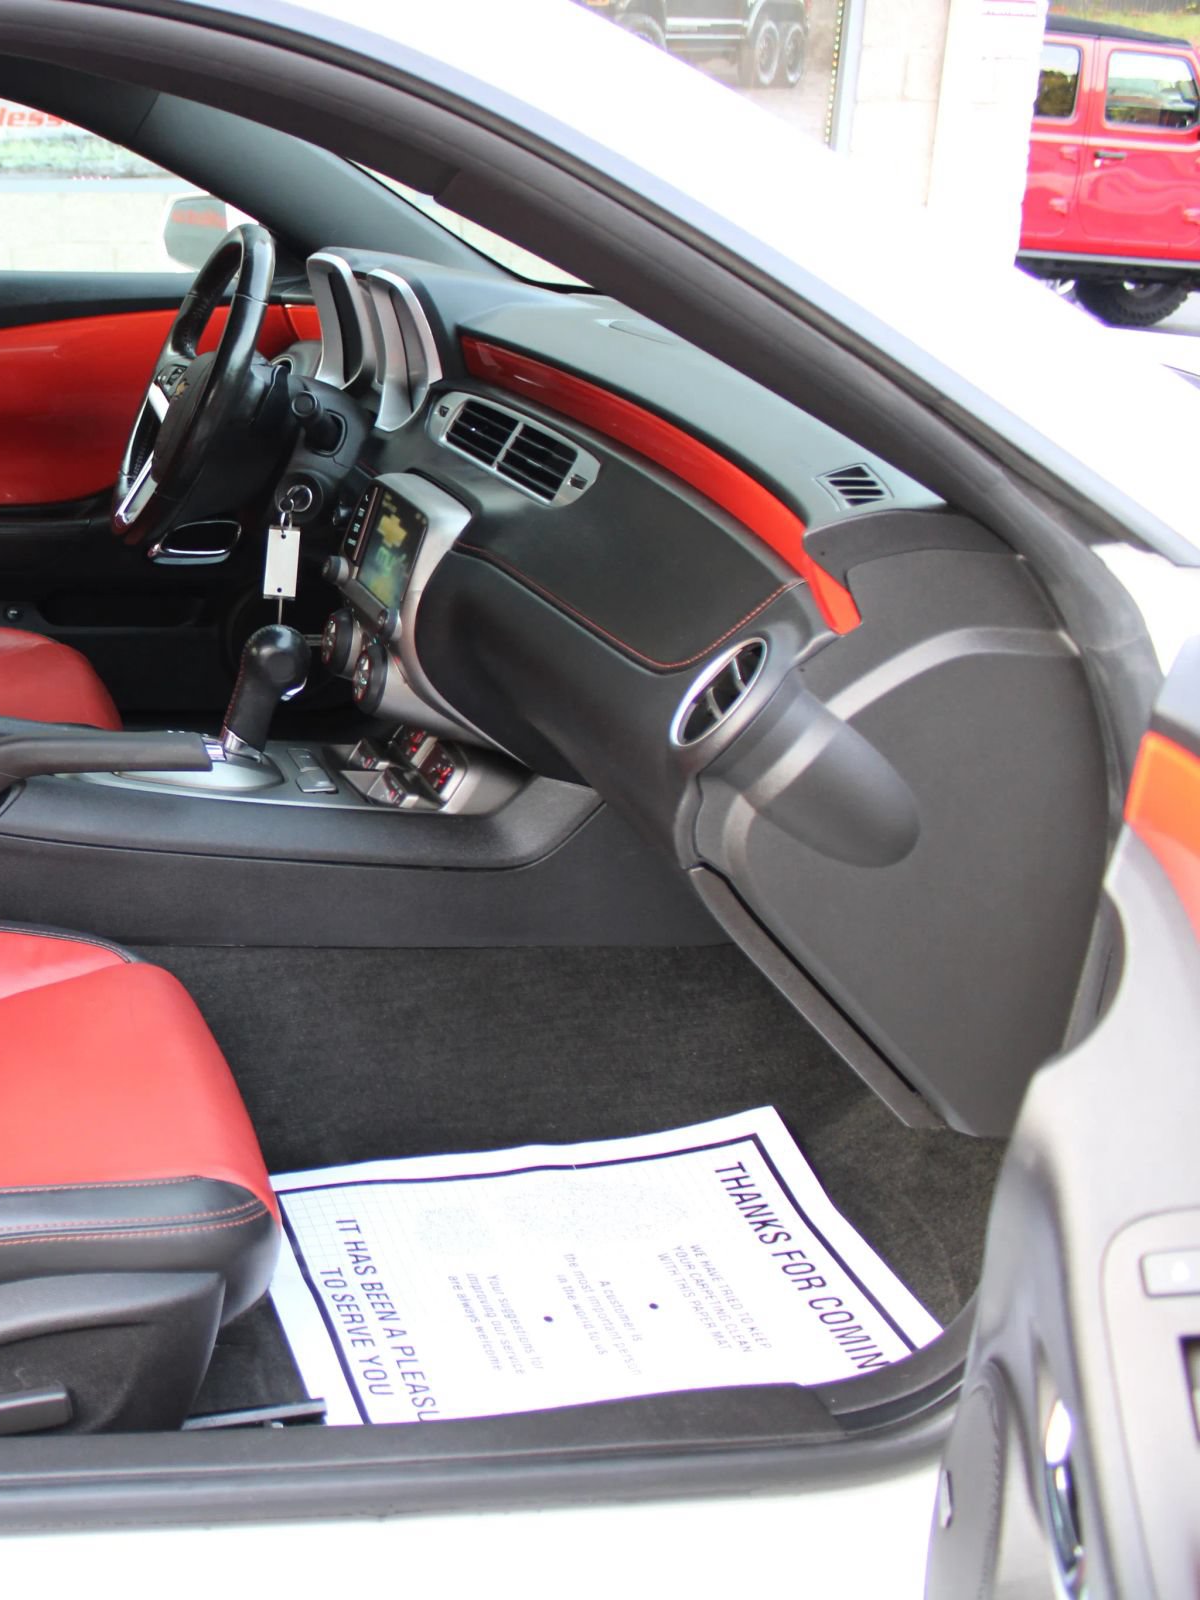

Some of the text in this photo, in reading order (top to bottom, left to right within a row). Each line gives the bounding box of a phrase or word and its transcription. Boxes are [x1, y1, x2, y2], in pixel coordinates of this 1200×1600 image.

[336, 1219, 361, 1234] IT
[344, 1240, 377, 1276] HAS
[714, 1160, 792, 1245] THANKS
[771, 1249, 827, 1291] FOR
[320, 1267, 395, 1396] TO SERVE YOU
[360, 1281, 401, 1321] BEEN
[382, 1327, 408, 1339] A
[448, 1275, 502, 1371] are always welcome
[486, 1273, 545, 1369] Your suggestions for
[556, 1274, 609, 1355] in the world to us
[563, 1252, 642, 1376] the most important person
[599, 1280, 643, 1342] A customer is
[657, 1252, 732, 1349] WITH THIS PAPER MAT
[673, 1245, 752, 1352] YOUR CARPETING CLEAN
[690, 1244, 772, 1349] WE HAVE TRIED TO KEEP
[490, 1320, 506, 1335] our
[500, 1338, 526, 1375] service
